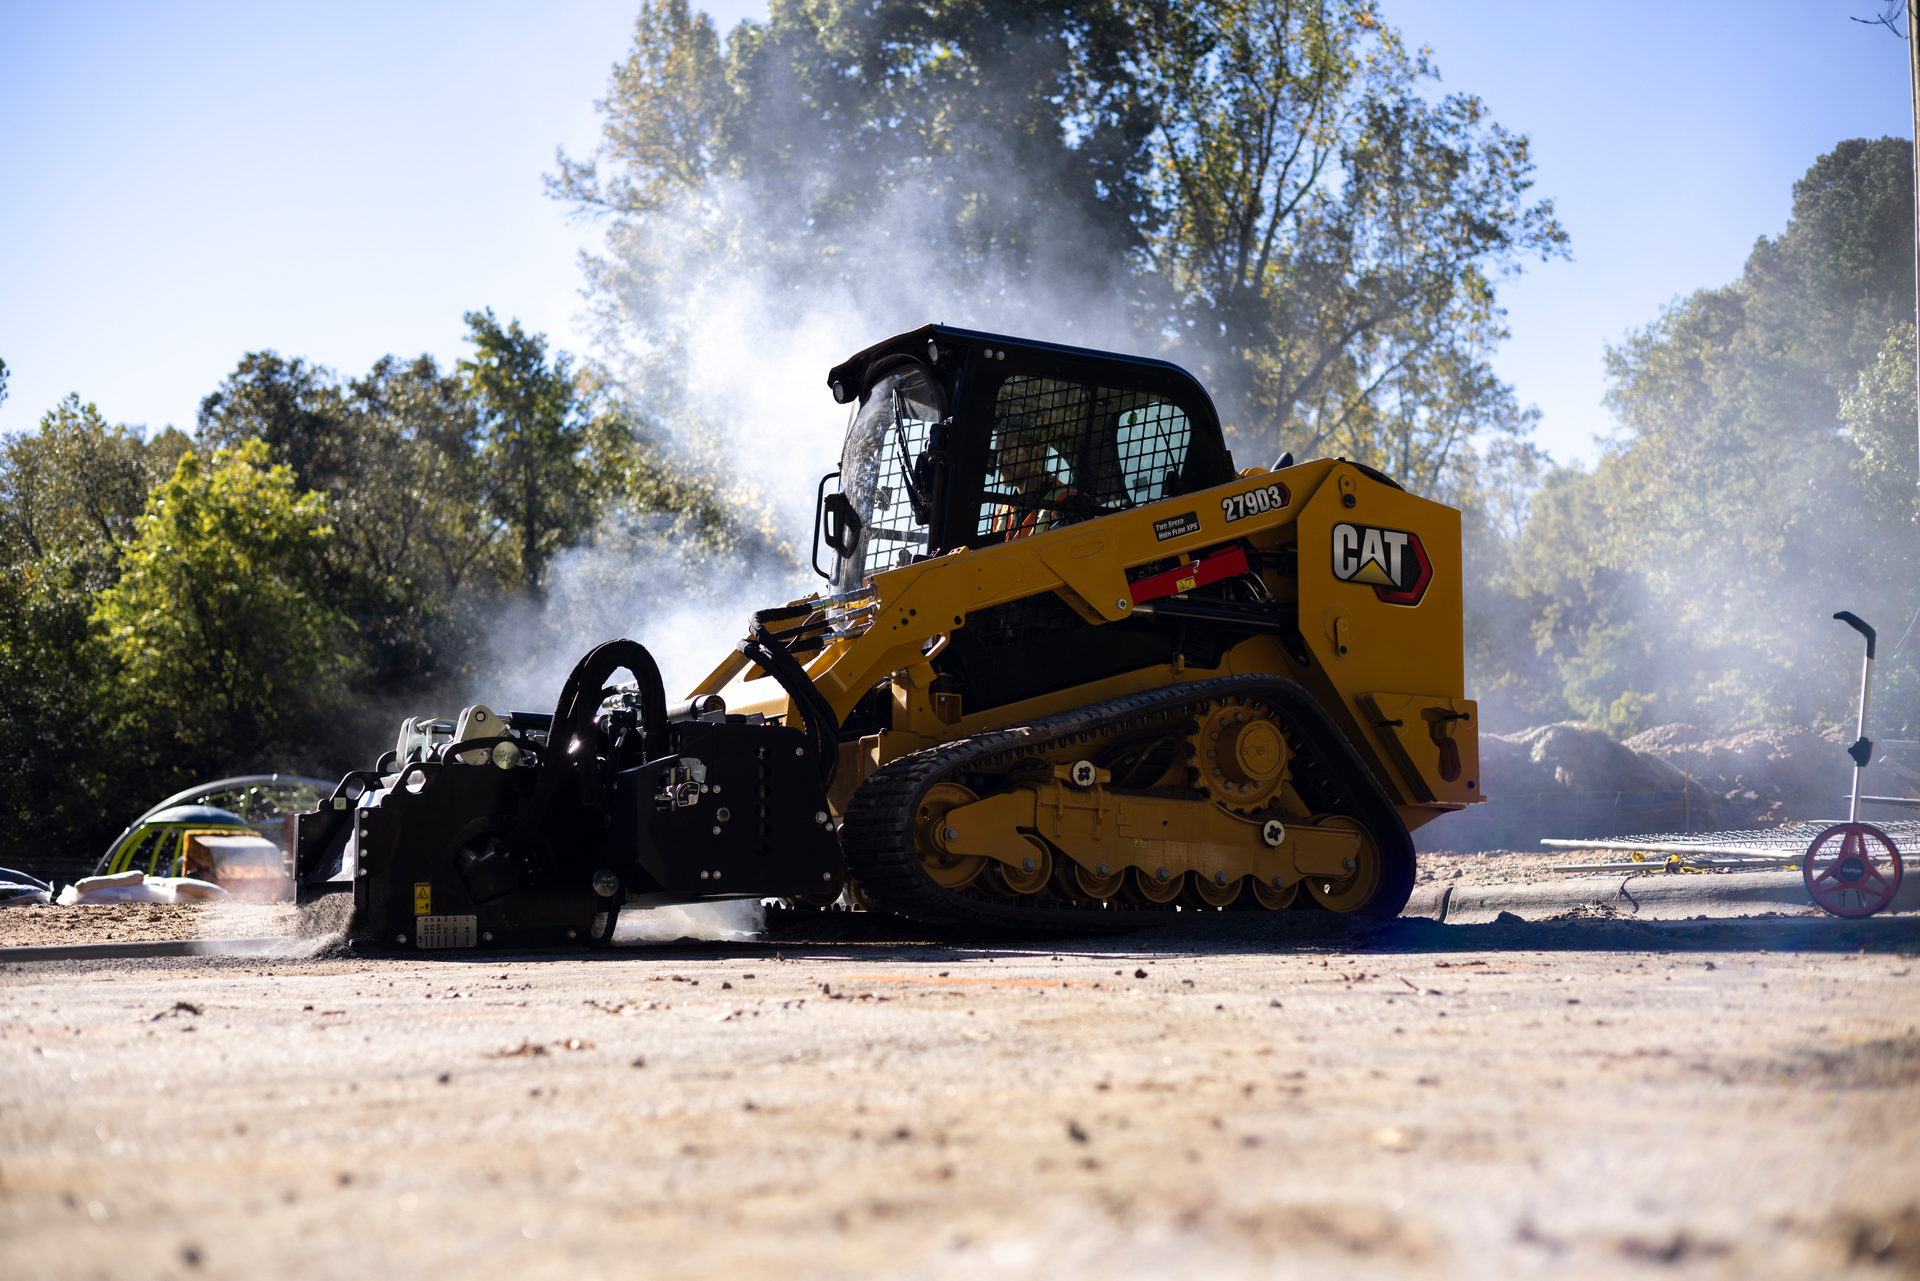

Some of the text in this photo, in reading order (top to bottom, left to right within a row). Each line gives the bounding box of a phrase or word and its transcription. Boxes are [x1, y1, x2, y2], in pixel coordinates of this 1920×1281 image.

[1222, 485, 1282, 522] 279D3
[1186, 522, 1198, 532] XPS
[1333, 523, 1408, 587] CAT
